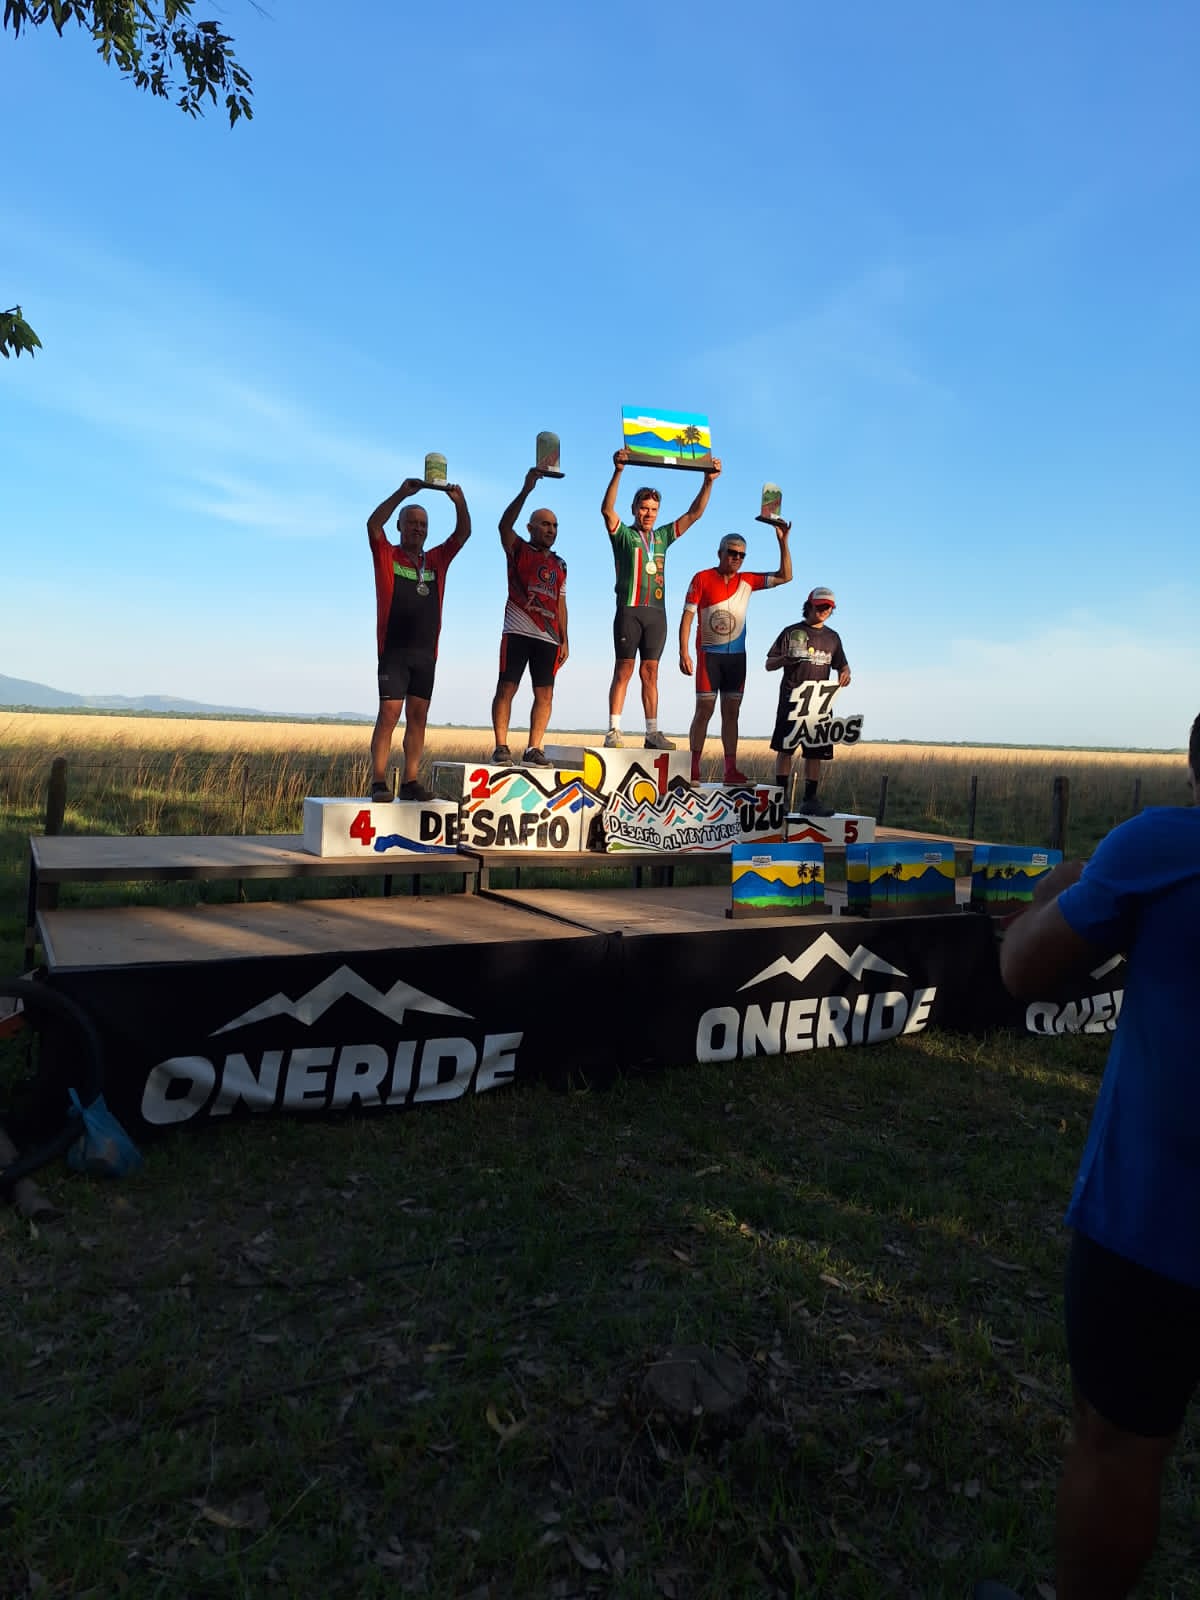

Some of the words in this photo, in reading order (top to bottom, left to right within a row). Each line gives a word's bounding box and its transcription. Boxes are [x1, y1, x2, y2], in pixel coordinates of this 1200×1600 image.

[797, 684, 840, 717] 17
[789, 716, 862, 748] AÑOS
[469, 768, 491, 799] 2
[654, 753, 669, 796] 1
[349, 810, 376, 846] 4
[419, 808, 570, 849] DESAFÍO
[663, 834, 682, 850] AL
[843, 820, 859, 844] 5
[696, 986, 937, 1063] ONERIDE
[140, 1031, 524, 1125] ONERIDE
